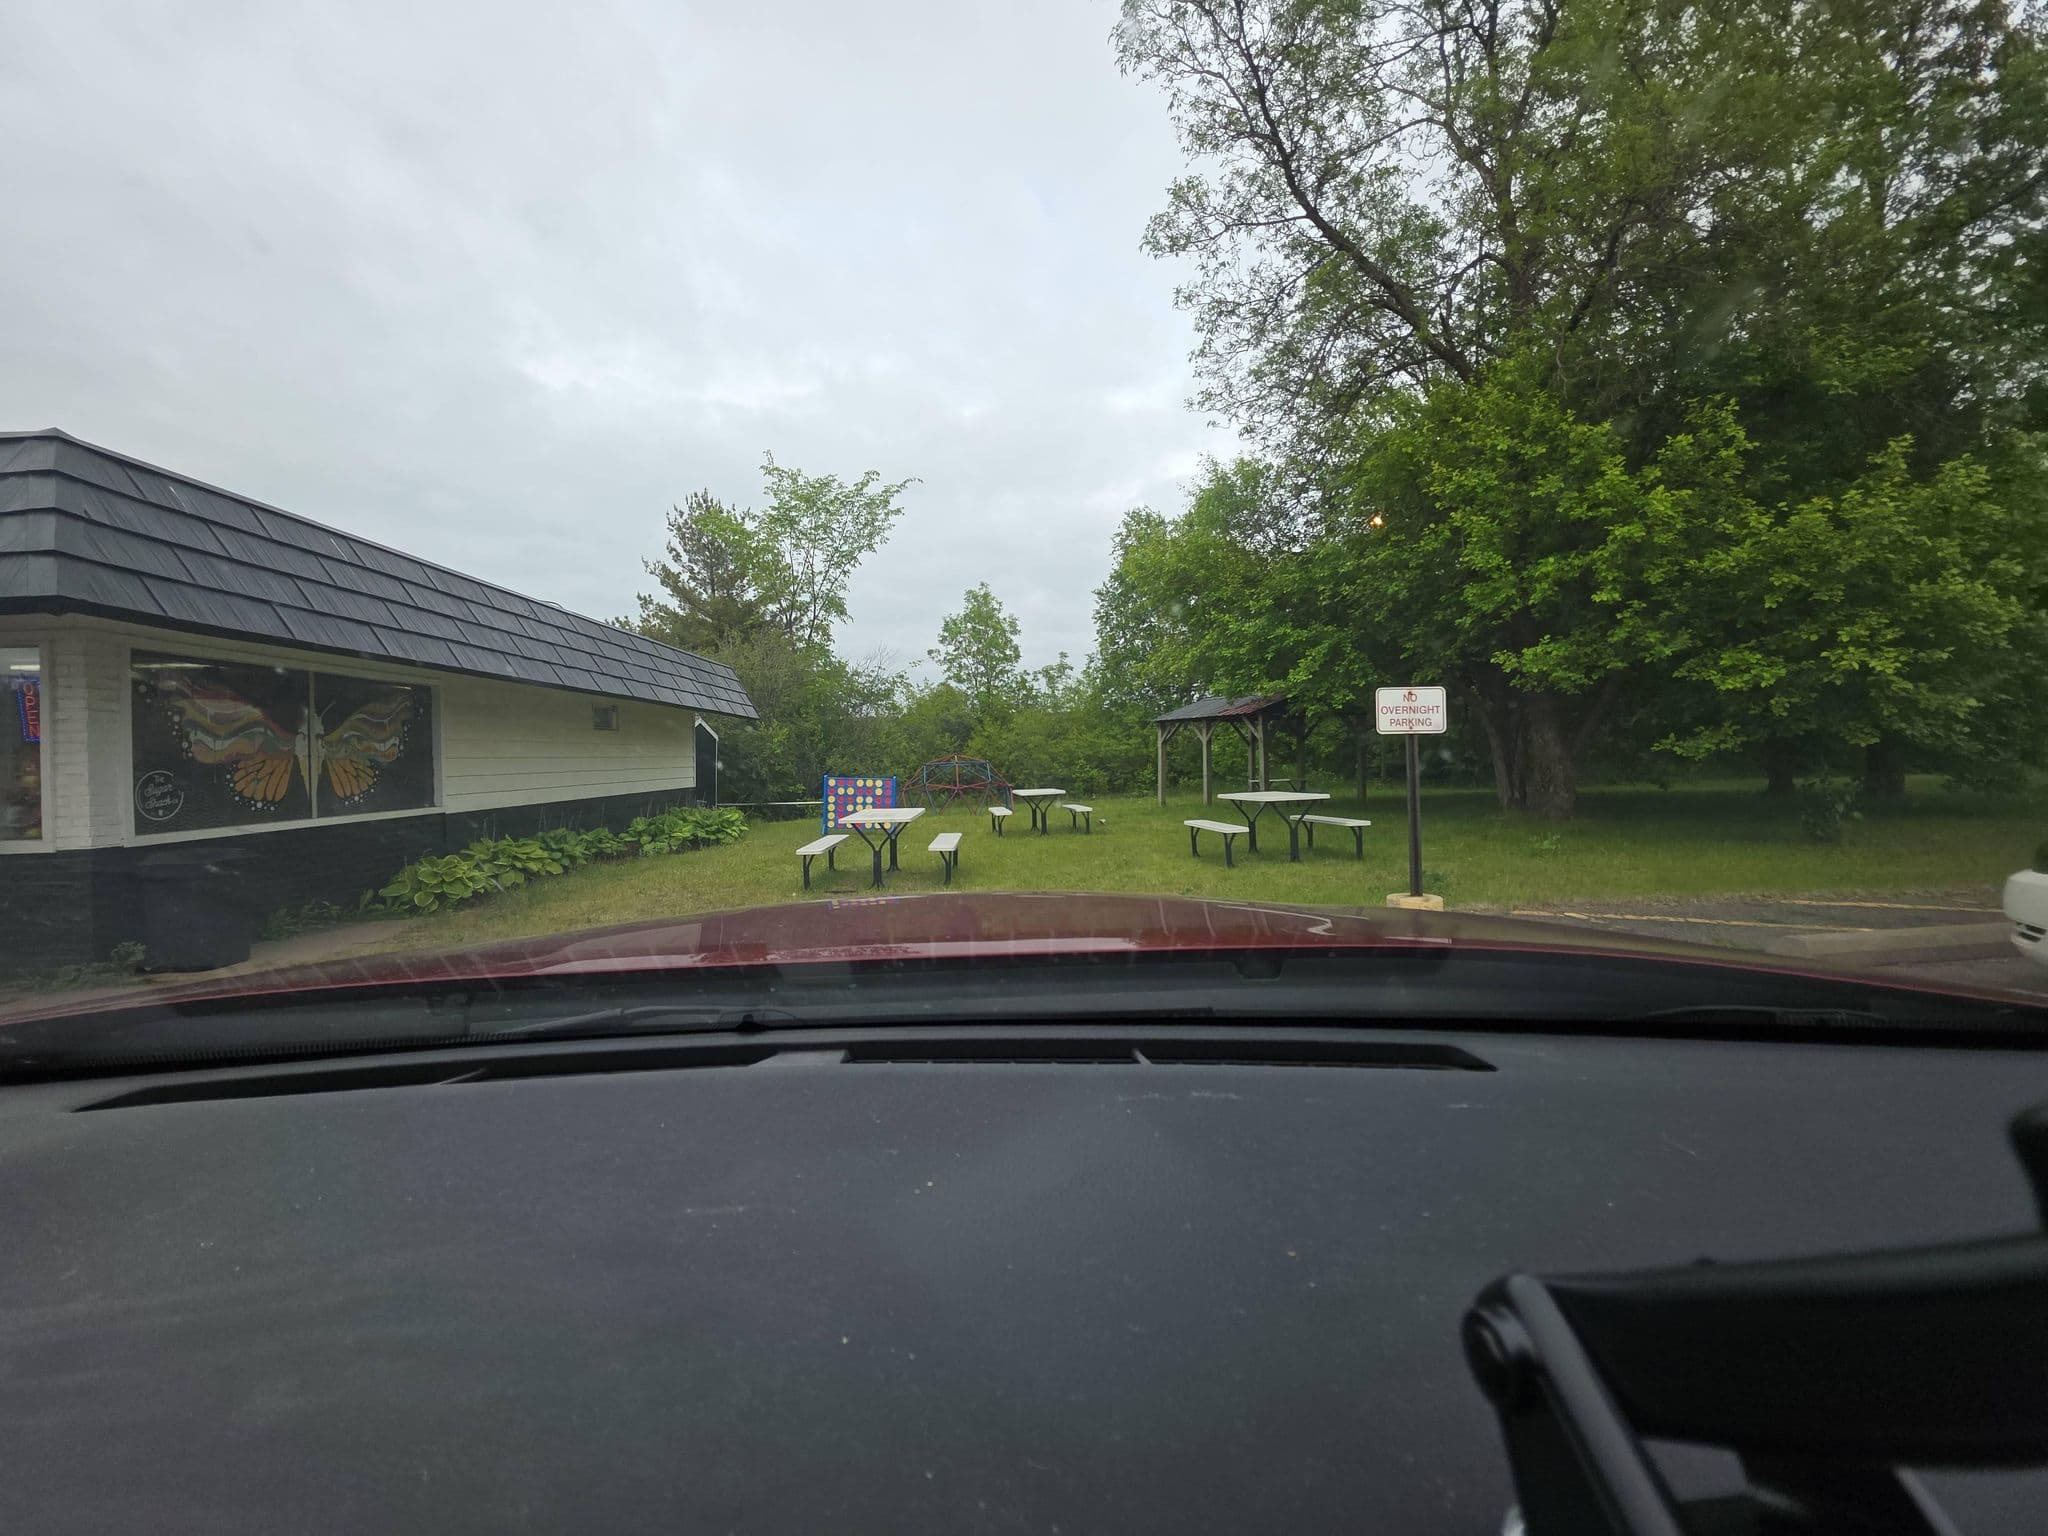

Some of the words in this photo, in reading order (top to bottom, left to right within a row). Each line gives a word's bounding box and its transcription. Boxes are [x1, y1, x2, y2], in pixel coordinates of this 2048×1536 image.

[1403, 694, 1417, 702] NO
[23, 683, 40, 737] OPEN
[1381, 705, 1440, 715] OVERNIGHT
[1389, 718, 1432, 727] PARKING
